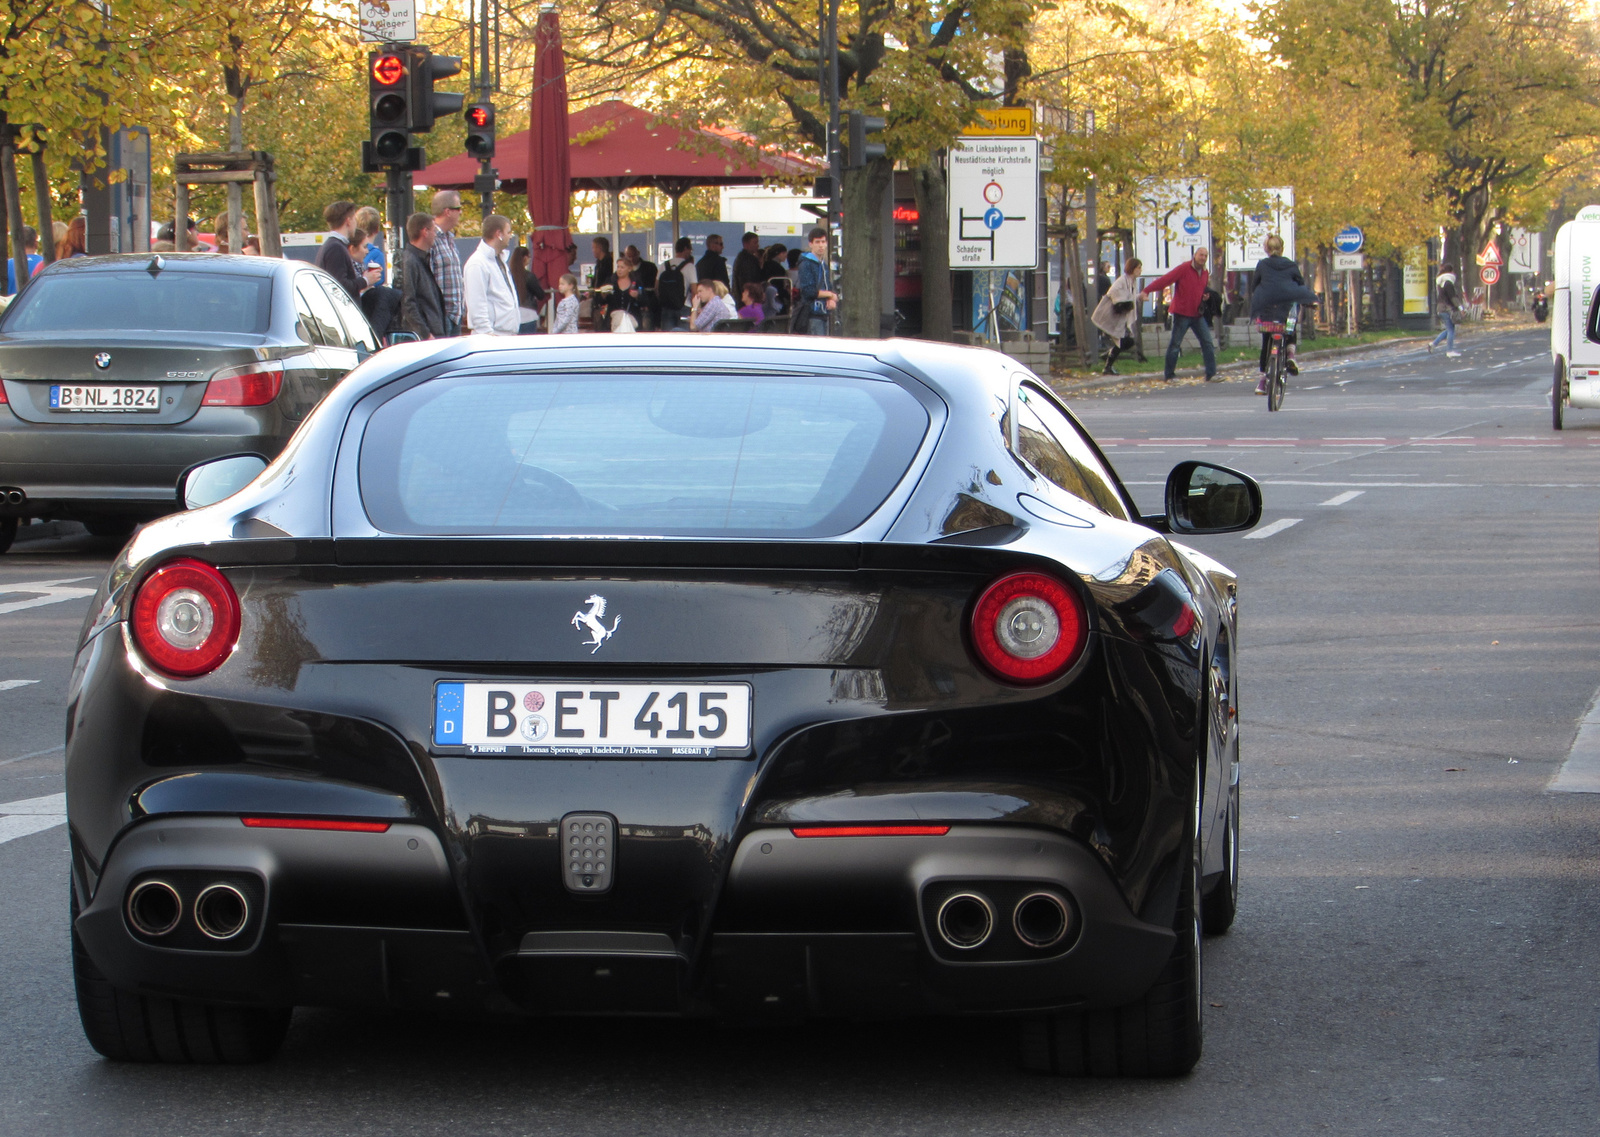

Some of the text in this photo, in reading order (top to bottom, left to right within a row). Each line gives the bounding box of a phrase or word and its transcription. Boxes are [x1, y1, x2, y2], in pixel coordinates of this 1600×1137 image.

[370, 19, 406, 29] Alieger
[976, 145, 1018, 154] Linksabbiegen
[1020, 144, 1026, 152] in
[955, 155, 996, 164] Neustädtische
[998, 155, 1031, 164] Kirchstraße
[981, 167, 1005, 176] möglich
[956, 245, 986, 253] Schadow-
[962, 254, 981, 262] straße
[1582, 255, 1591, 282] HOW
[1484, 270, 1495, 279] 30
[1582, 285, 1591, 306] BUT
[61, 388, 156, 406] B NL 1824
[487, 690, 517, 737] B
[555, 691, 620, 738] ET
[634, 691, 728, 739] 415
[443, 720, 454, 733] D
[521, 745, 549, 753] Thomas
[550, 746, 591, 755] Sportwagen
